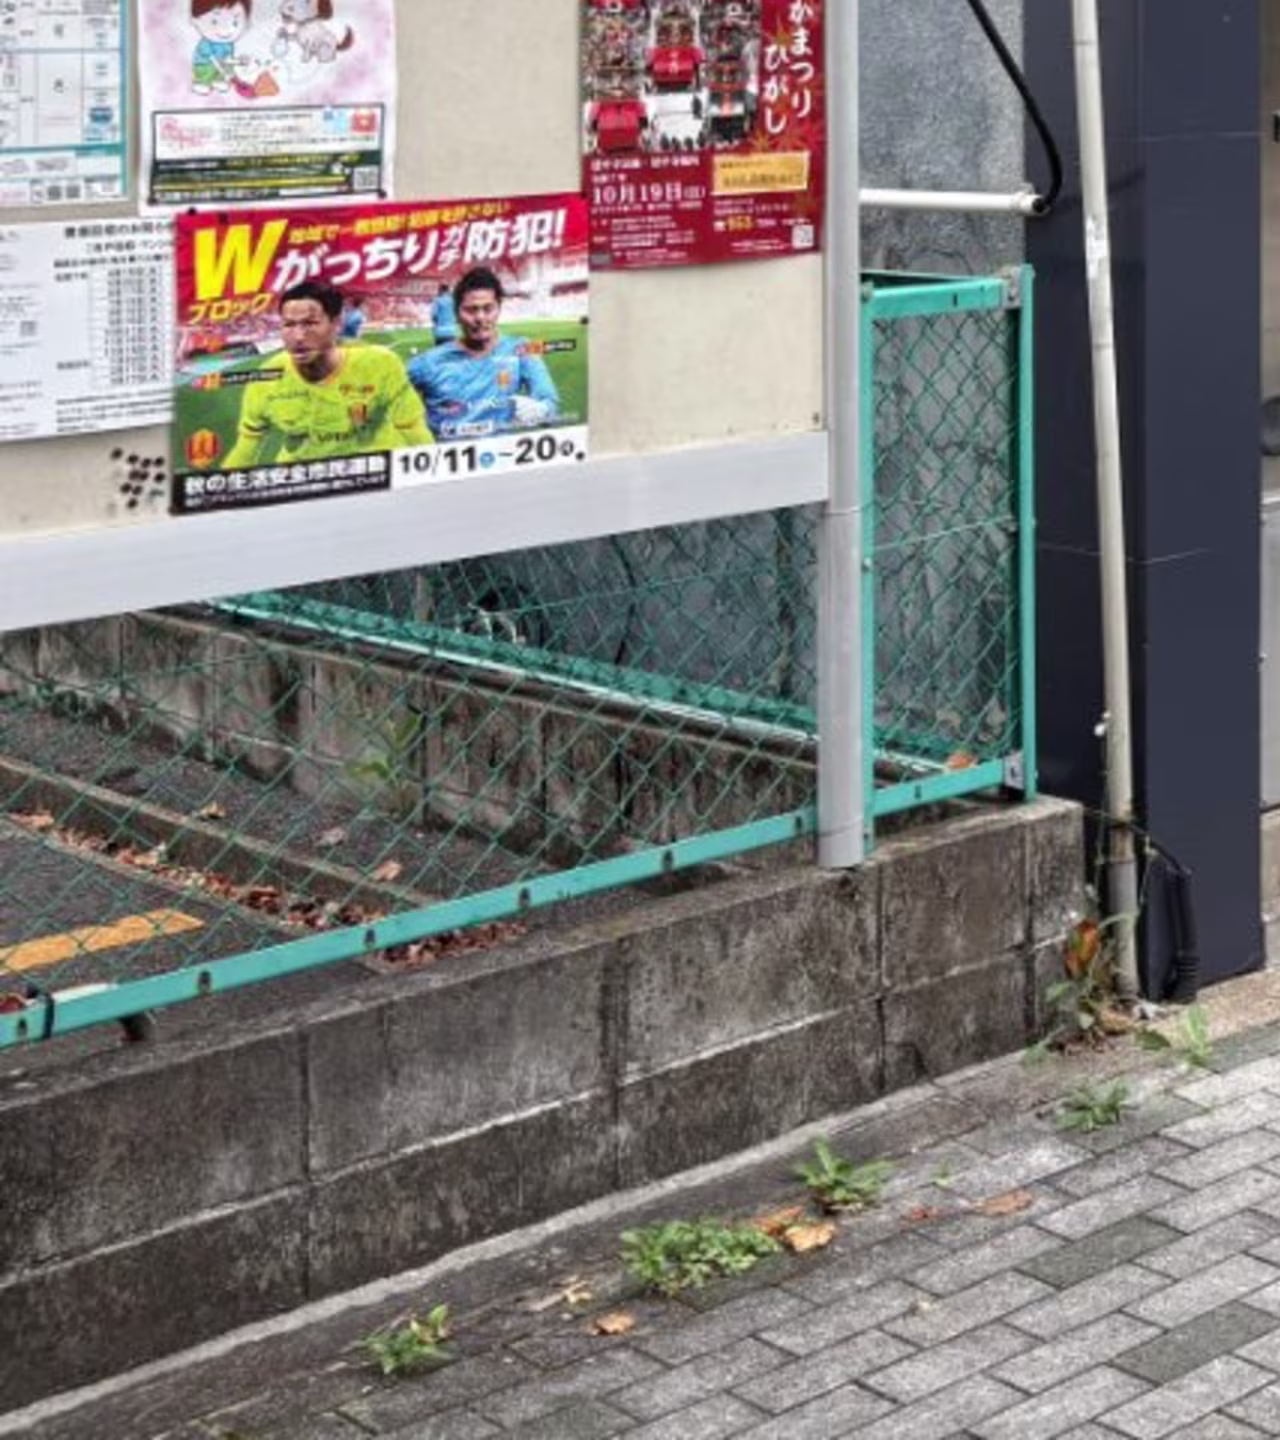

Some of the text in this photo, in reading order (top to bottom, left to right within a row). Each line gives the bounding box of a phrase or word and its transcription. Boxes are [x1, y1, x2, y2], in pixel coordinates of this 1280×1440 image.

[764, 43, 790, 135] ひがし
[193, 218, 289, 301] W
[187, 292, 271, 325] ブロック
